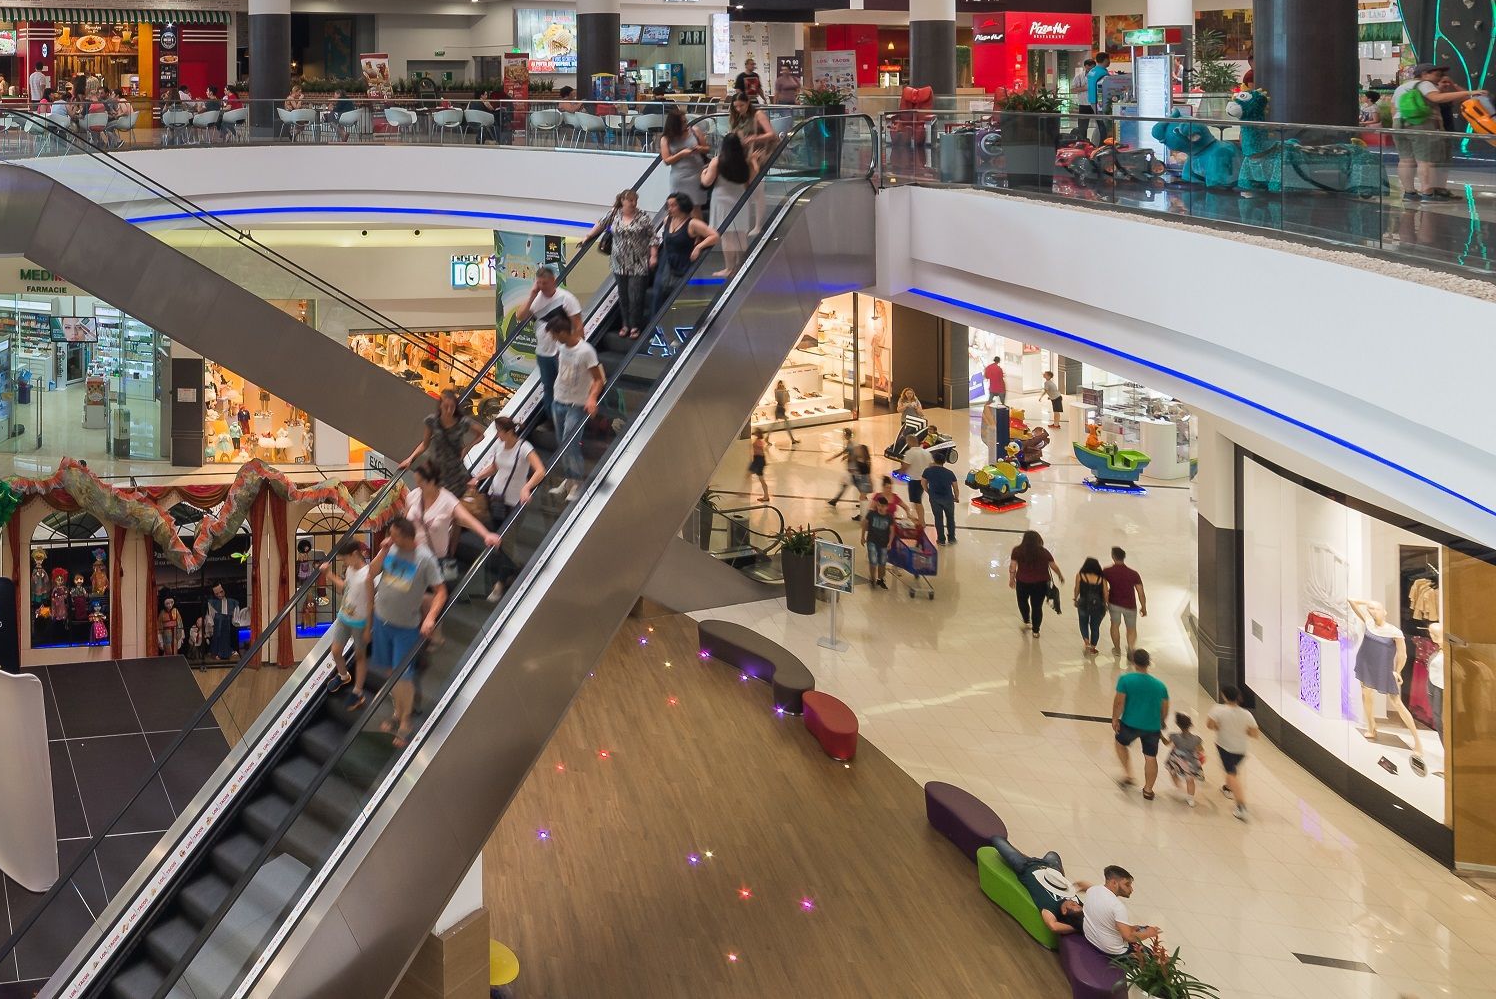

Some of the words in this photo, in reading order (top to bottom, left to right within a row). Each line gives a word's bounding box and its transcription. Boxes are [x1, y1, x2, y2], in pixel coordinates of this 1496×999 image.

[1030, 21, 1052, 35] Pizza
[1053, 22, 1070, 34] Hut
[27, 285, 67, 294] FARMACIE
